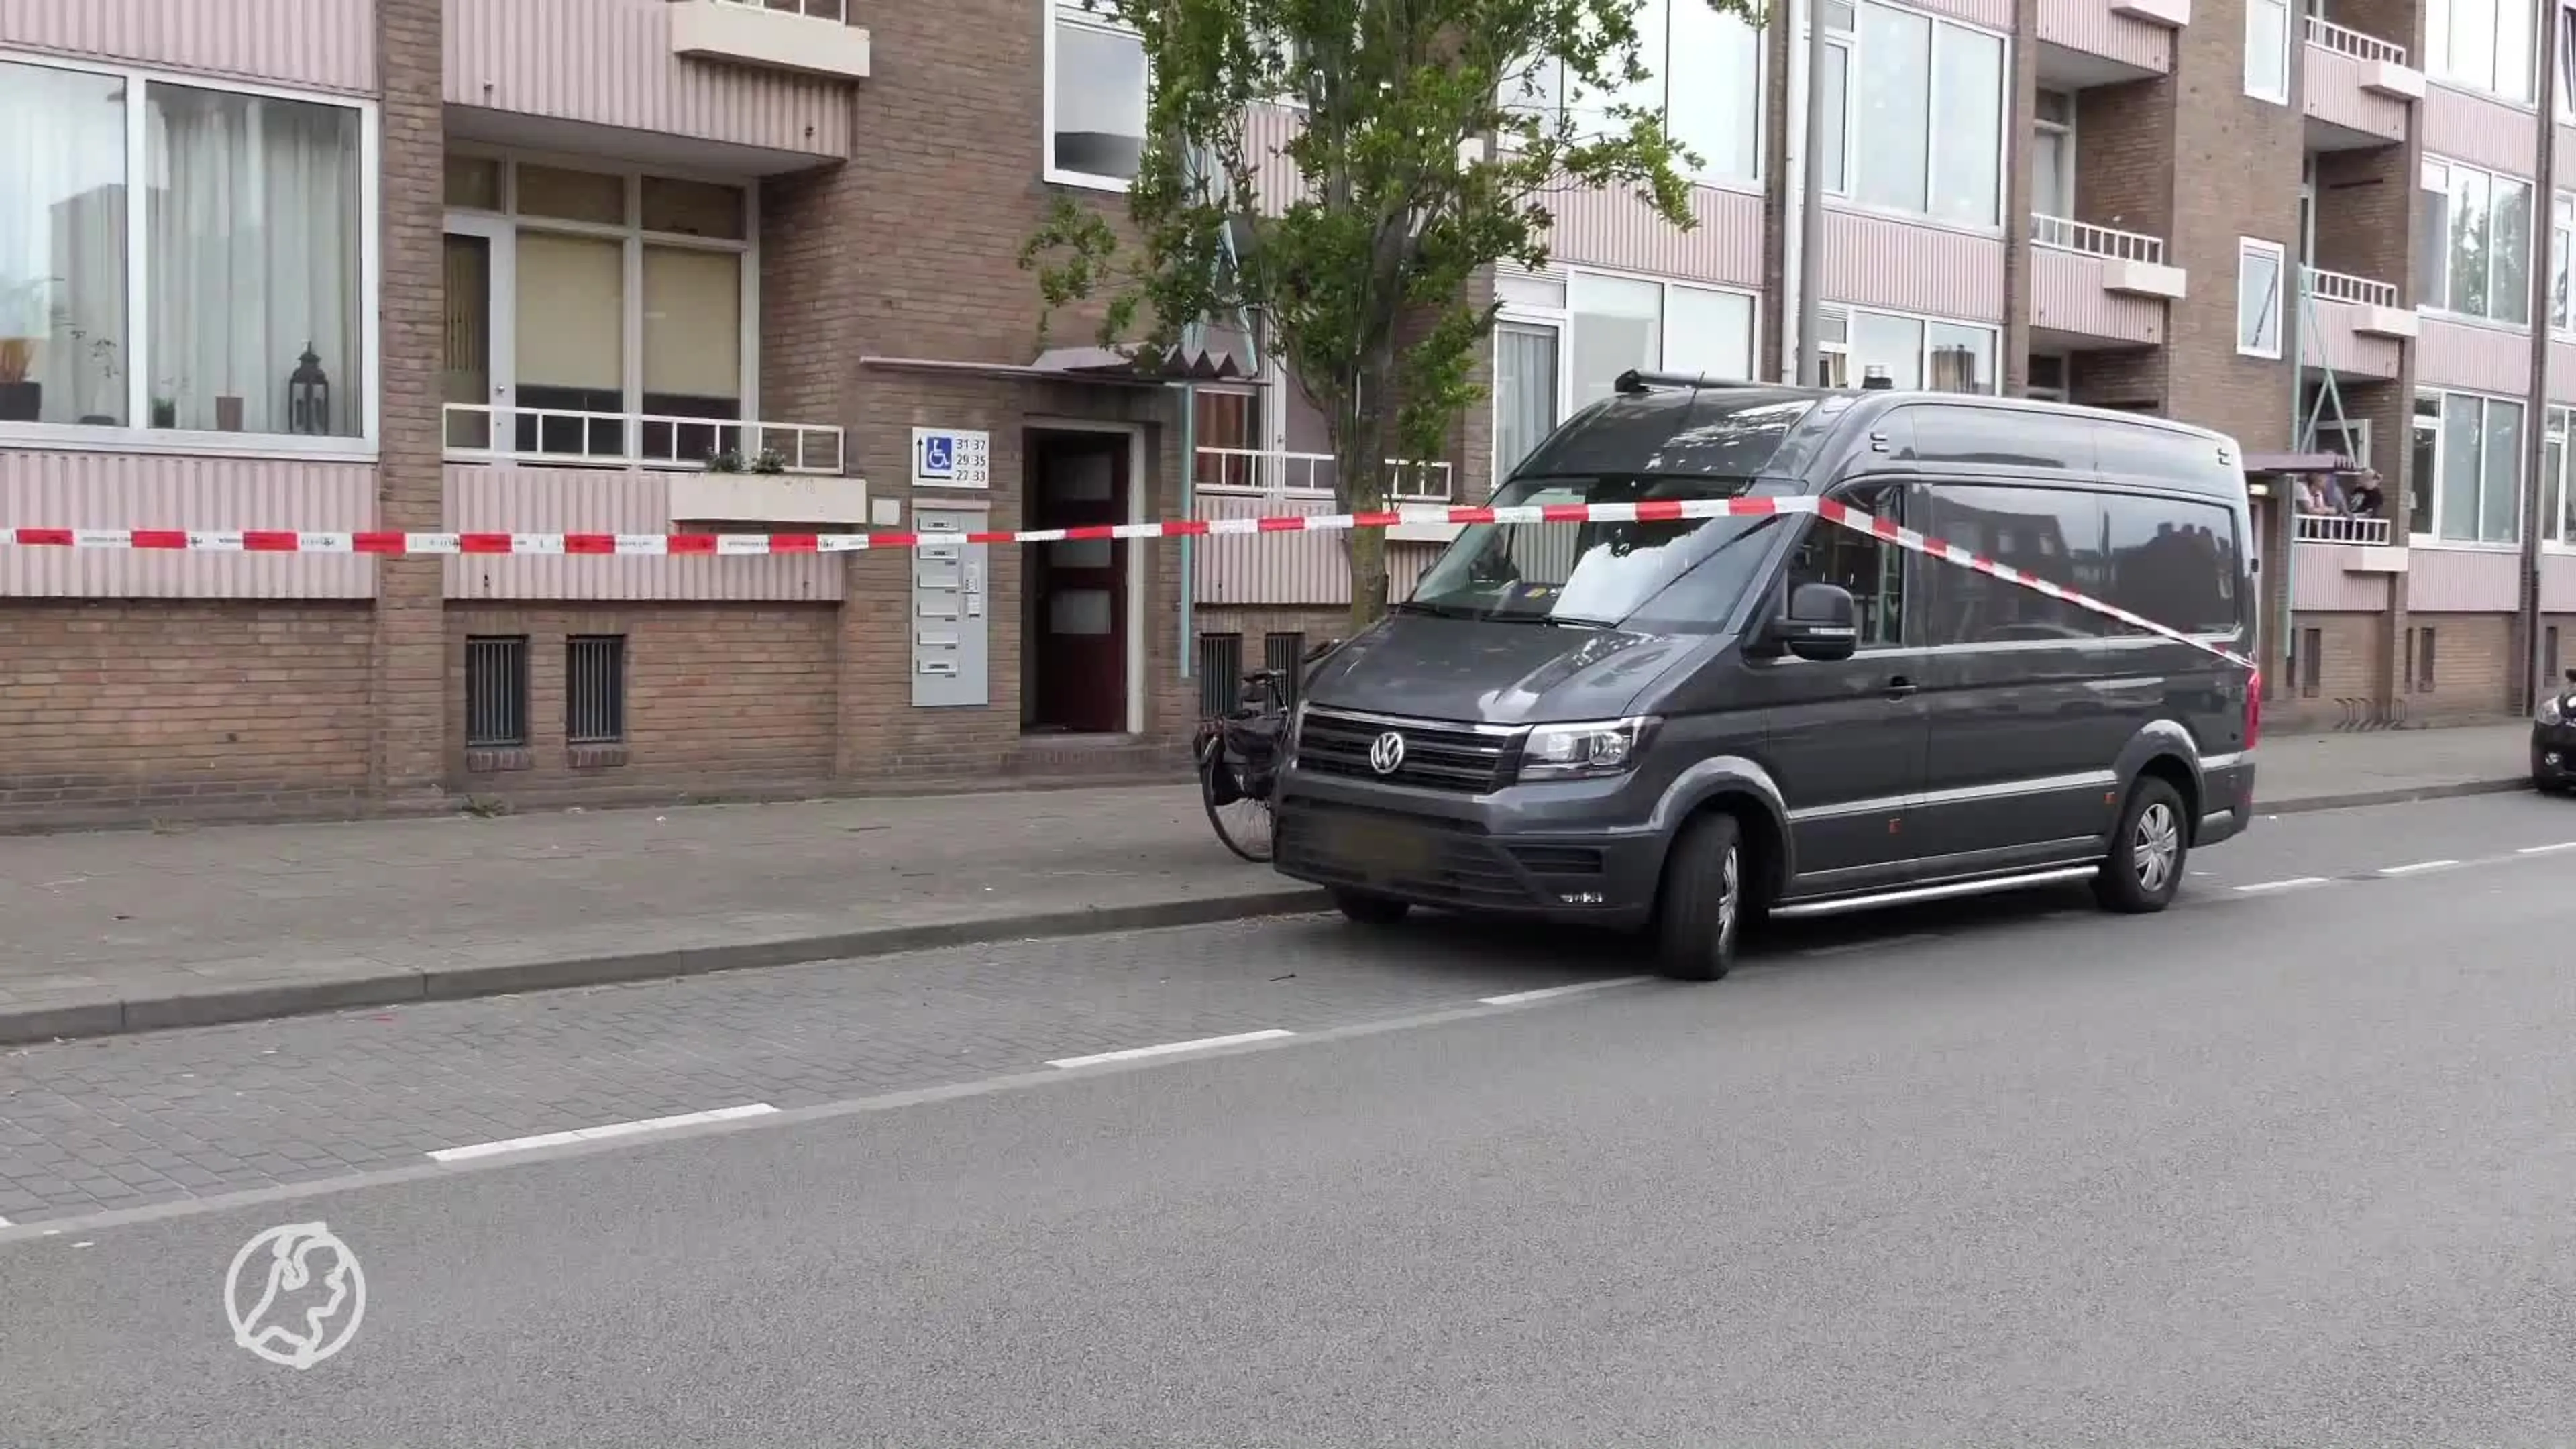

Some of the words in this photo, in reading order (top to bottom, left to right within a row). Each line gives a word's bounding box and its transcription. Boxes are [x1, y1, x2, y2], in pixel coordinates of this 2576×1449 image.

[956, 439, 968, 449] 31
[973, 440, 985, 450] 37
[956, 453, 969, 465] 29
[973, 455, 985, 466] 35
[973, 471, 985, 482] 33
